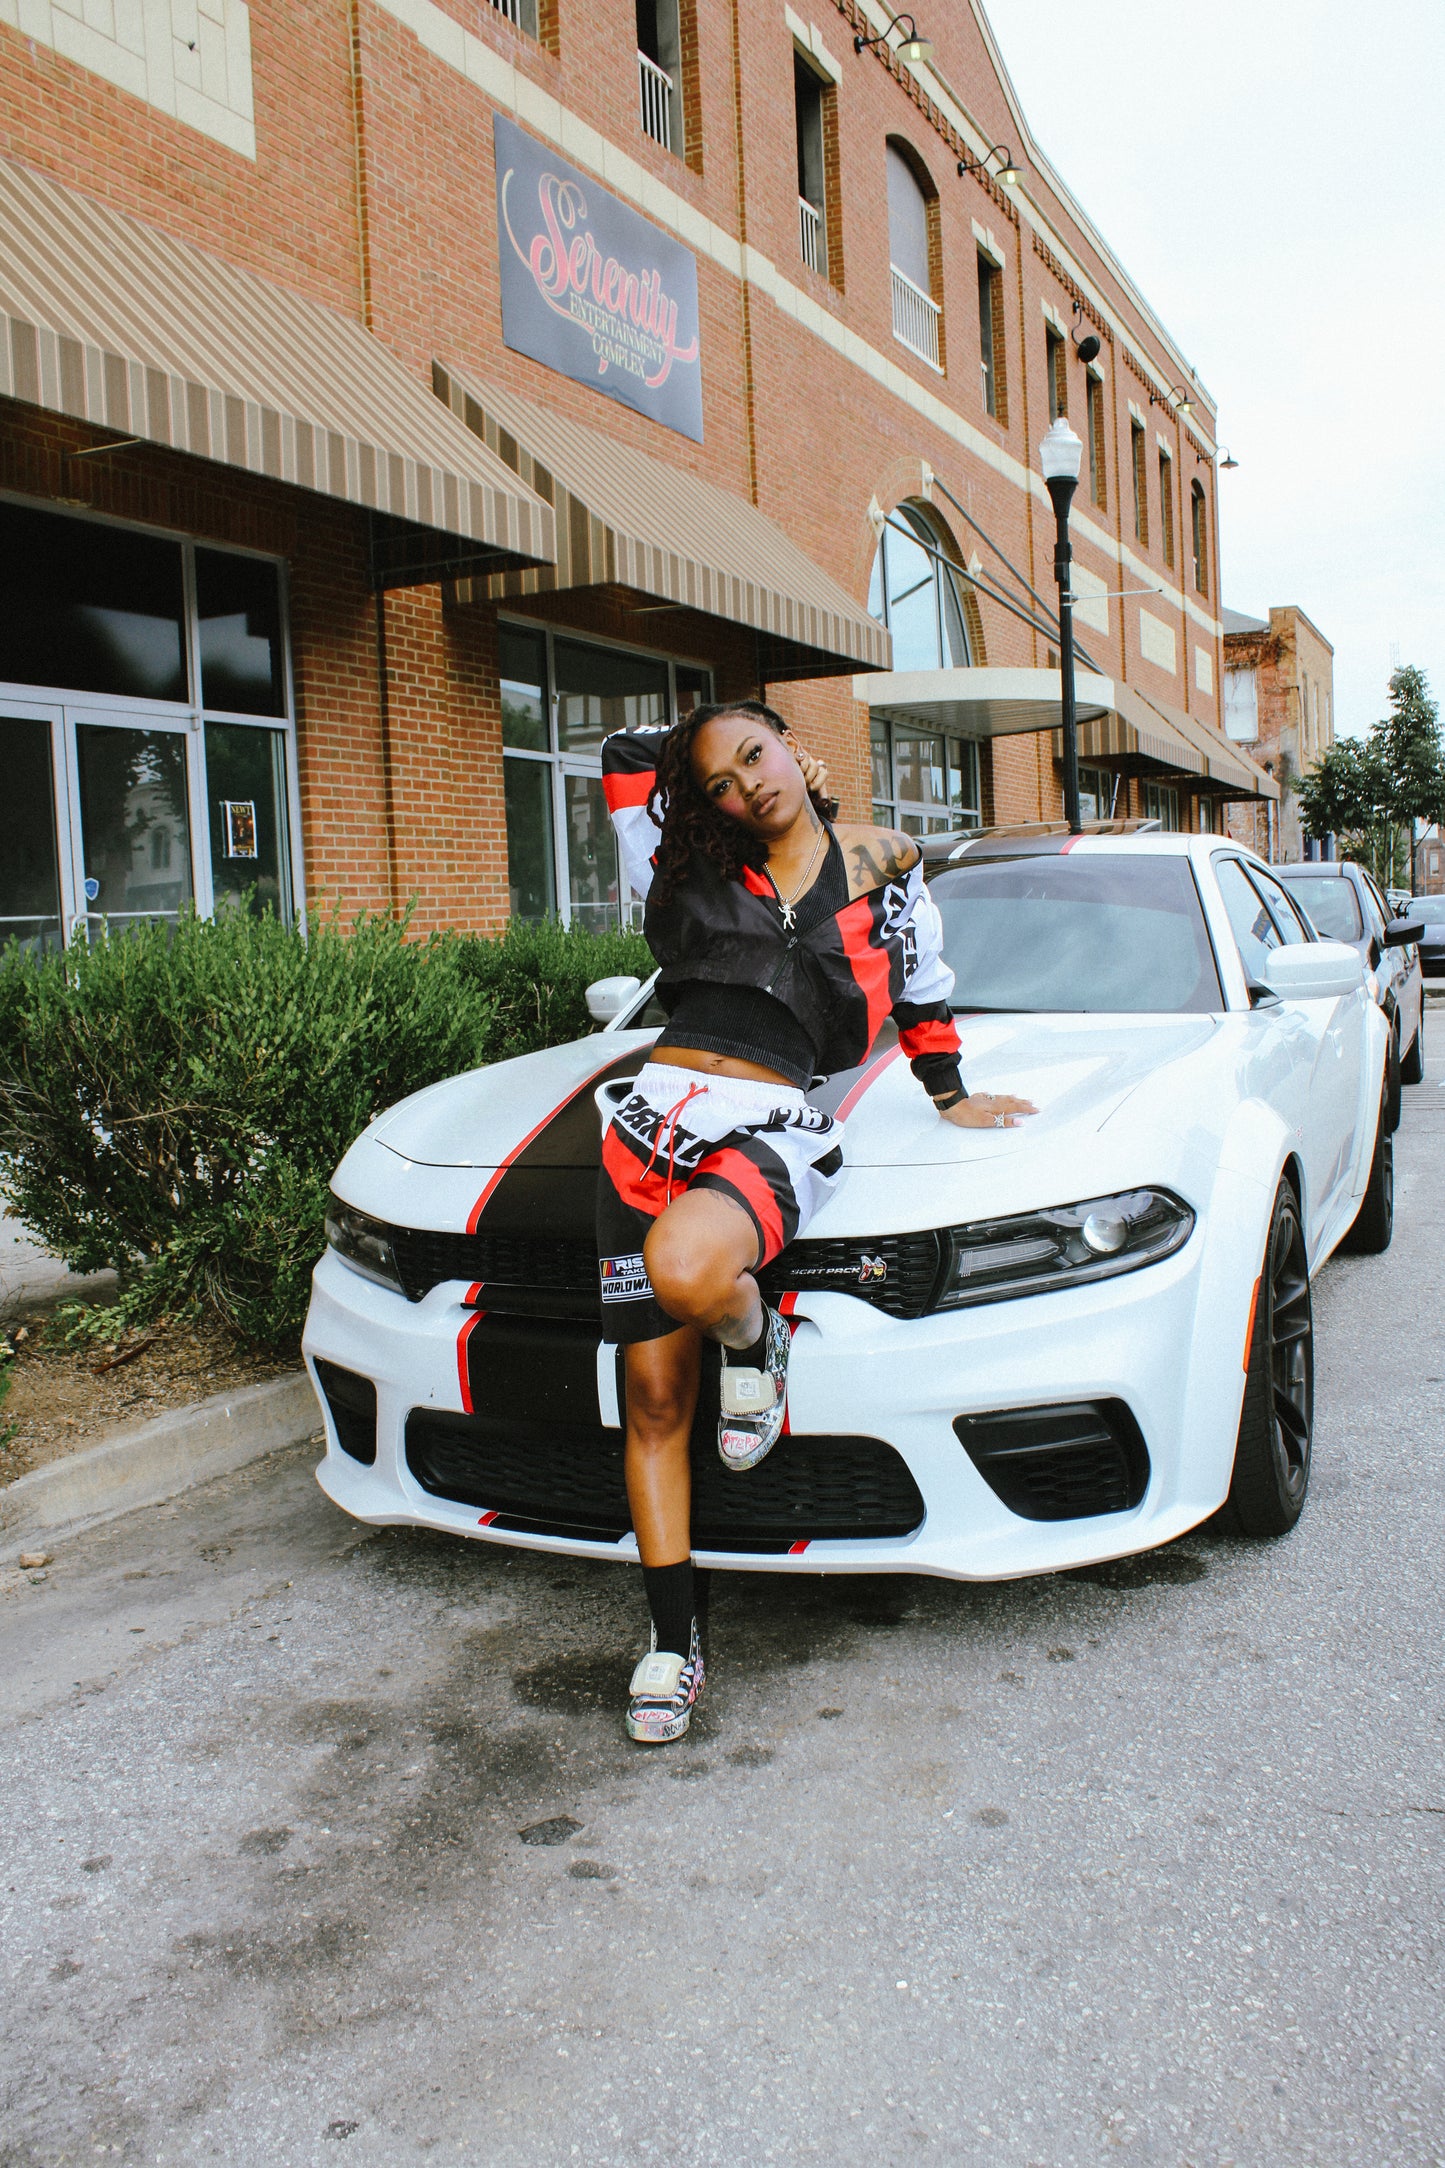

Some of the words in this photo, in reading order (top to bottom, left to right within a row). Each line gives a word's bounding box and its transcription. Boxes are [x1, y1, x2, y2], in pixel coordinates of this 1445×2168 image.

[528, 172, 699, 388] Serenity
[570, 291, 664, 365] ENTERTAINMENT
[592, 332, 646, 380] COMPLEX
[602, 1277, 652, 1295] WORLDWI
